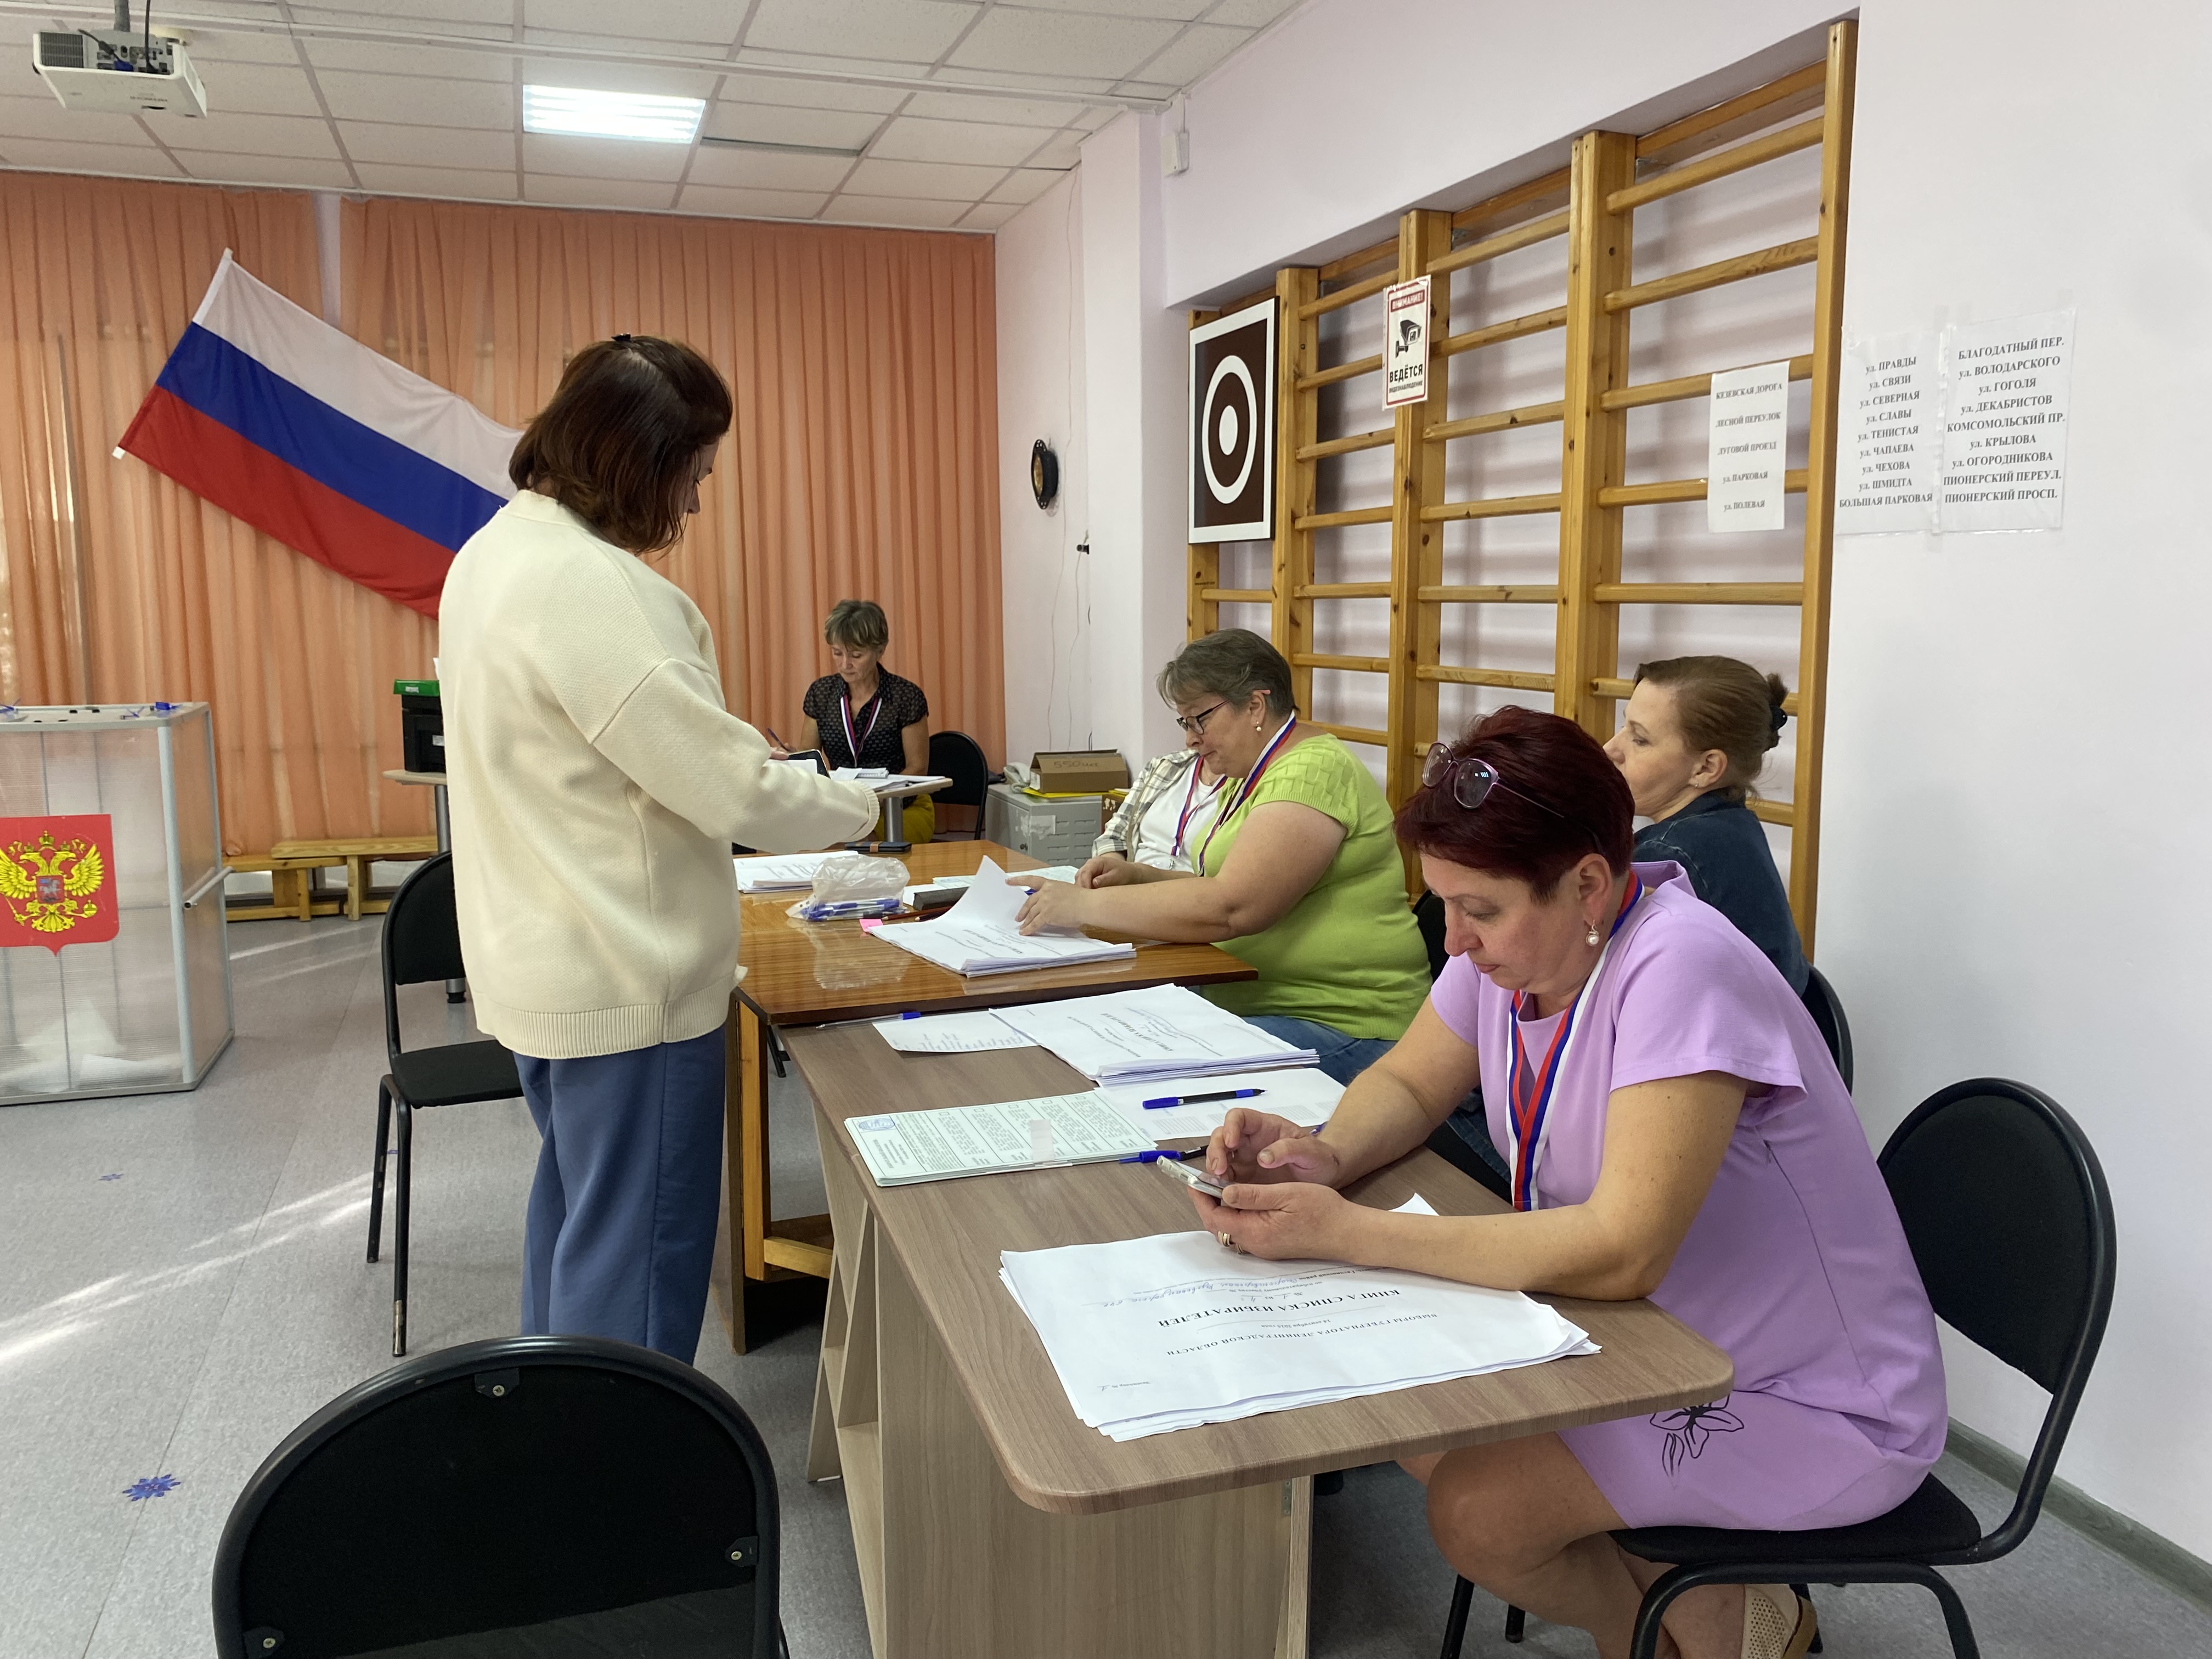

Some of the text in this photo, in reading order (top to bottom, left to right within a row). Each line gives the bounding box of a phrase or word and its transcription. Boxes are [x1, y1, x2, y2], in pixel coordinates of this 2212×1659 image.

[1392, 291, 1423, 310] ВНИМАНИЕ!
[1959, 337, 2064, 360] БЛАГОДАТНЫЙ ПЕР.
[1390, 364, 1423, 383] ВЕДЁТСЯ
[1865, 357, 1916, 375] ул. ПРАВДЫ
[1959, 356, 2061, 380] ул. ВОЛОДАРСКОГО
[1716, 383, 1782, 399] КЕЗЕВСКАЯ ДОРОГА
[1869, 375, 1911, 391] ул. СВЯЗИ
[1978, 378, 2036, 395] ул. ГОГОЛЯ
[1860, 391, 1920, 409] ул. СЕВЕРНАЯ
[1961, 395, 2052, 415] ул. ДЕКАБРИСТОВ
[1716, 413, 1781, 427] ЛЕСНОЙ ПЕРЕУЛОК
[1866, 409, 1911, 425] ул. СЛАВЫ
[1947, 413, 2066, 432] КОМСОМОЛЬСКИЙ ПР.
[1858, 426, 1918, 443] ул. ТЕНИСТАЯ
[1970, 435, 2036, 450] ул. КРЫЛОВА
[1718, 441, 1776, 455] ЛУГОВОЙ ПРОЕЗД
[1860, 444, 1914, 458] ул. ЧАПАЕВА
[1862, 461, 1910, 475] ул. ЧЕХОВА
[1952, 452, 2053, 470] ул. ОГОРОДНИКОВА
[1733, 471, 1768, 481] ПАРКОВАЯ
[1944, 470, 2062, 486] ПИОНЕРСКИЙ ПЕРЕУЛ.
[1859, 478, 1912, 492] ул. ШМИДТА
[1839, 493, 1933, 507] БОЛЬШАЯ ПАРКОВАЯ
[1945, 489, 2057, 503] ПИОНЕРСКИЙ ПРОСП.
[1734, 500, 1765, 509] ПОЛЕВАЯ
[1157, 1289, 1400, 1328] КНИГА СПИСКА ИЗБИРАТЕЛЕЙ
[1166, 1312, 1437, 1356] ВЫБОРЫ ГУБЕРНАТОРА ЛЕНИНГРАДСКОЙ ОБЛАСТИ
